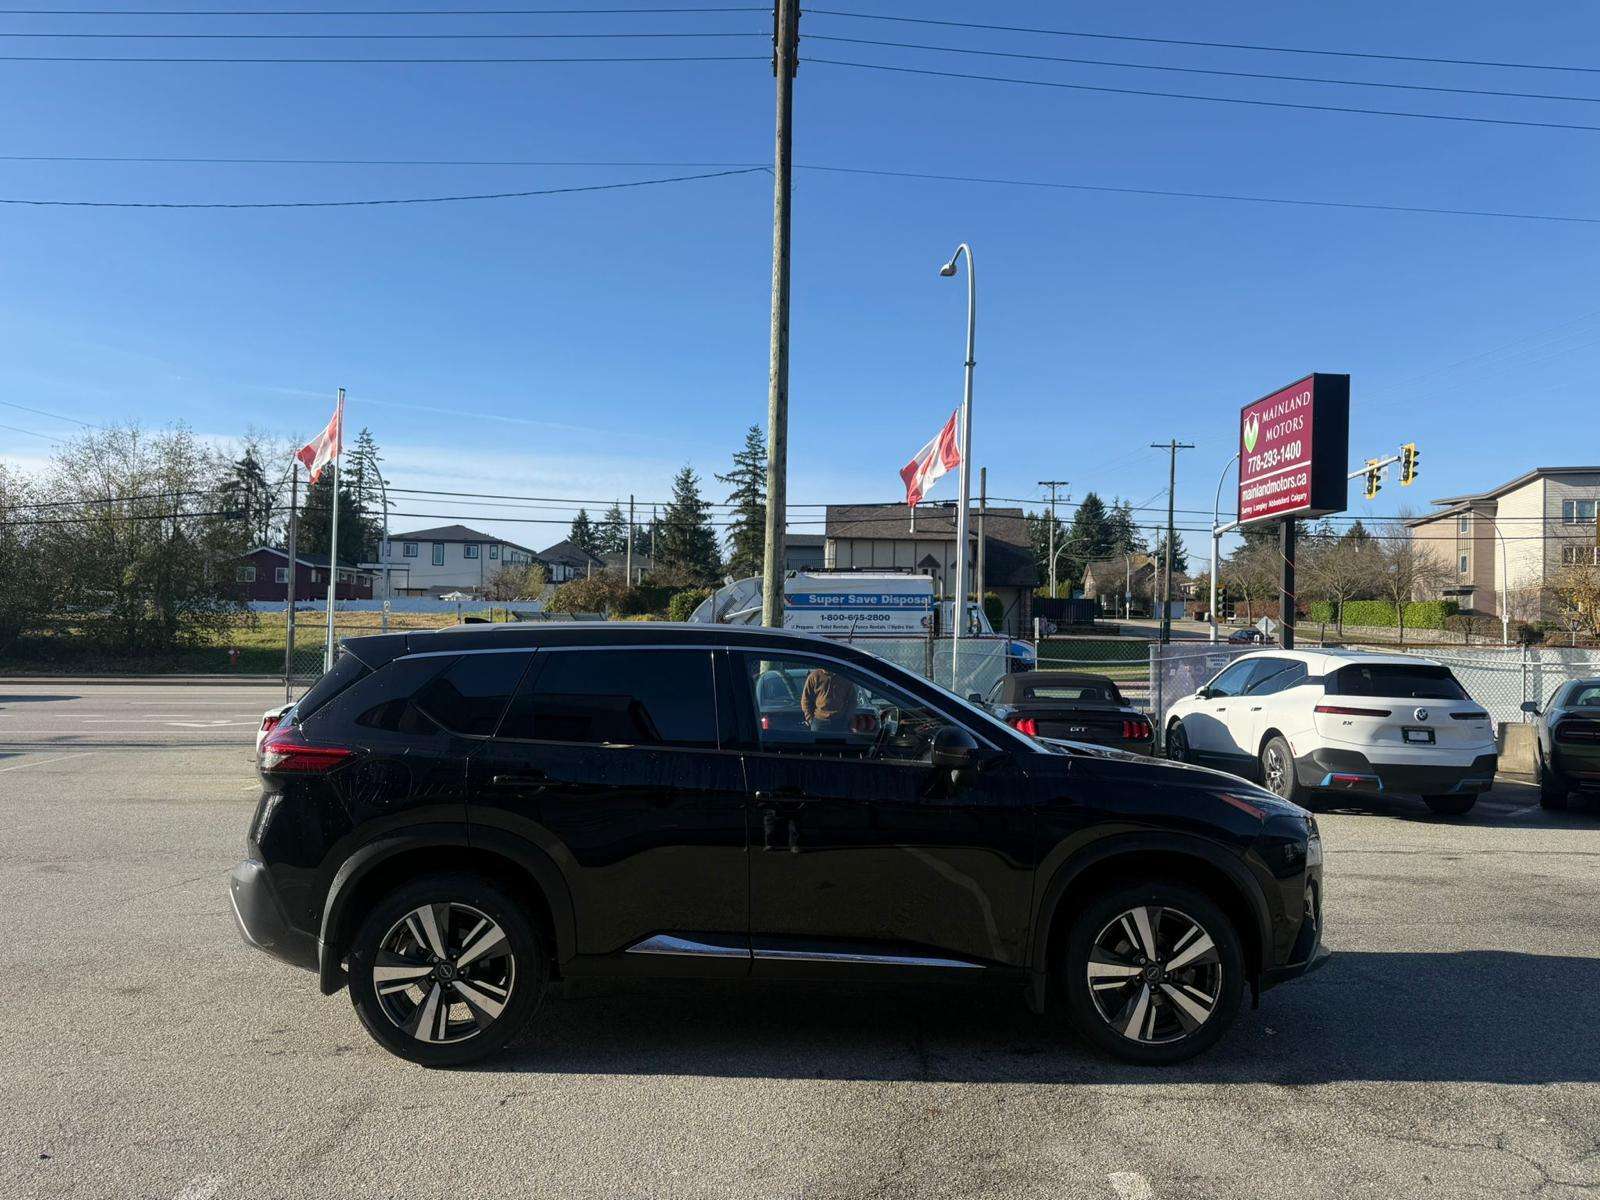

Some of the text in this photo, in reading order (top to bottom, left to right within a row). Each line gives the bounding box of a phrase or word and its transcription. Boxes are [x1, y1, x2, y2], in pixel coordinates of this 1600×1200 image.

[1262, 391, 1311, 423] MAINLAND
[1265, 415, 1304, 442] MOTORS
[1248, 440, 1302, 474] 778-293-1400
[1242, 472, 1307, 501] mainlandmotors.ca
[809, 594, 931, 606] Super Save Disposal
